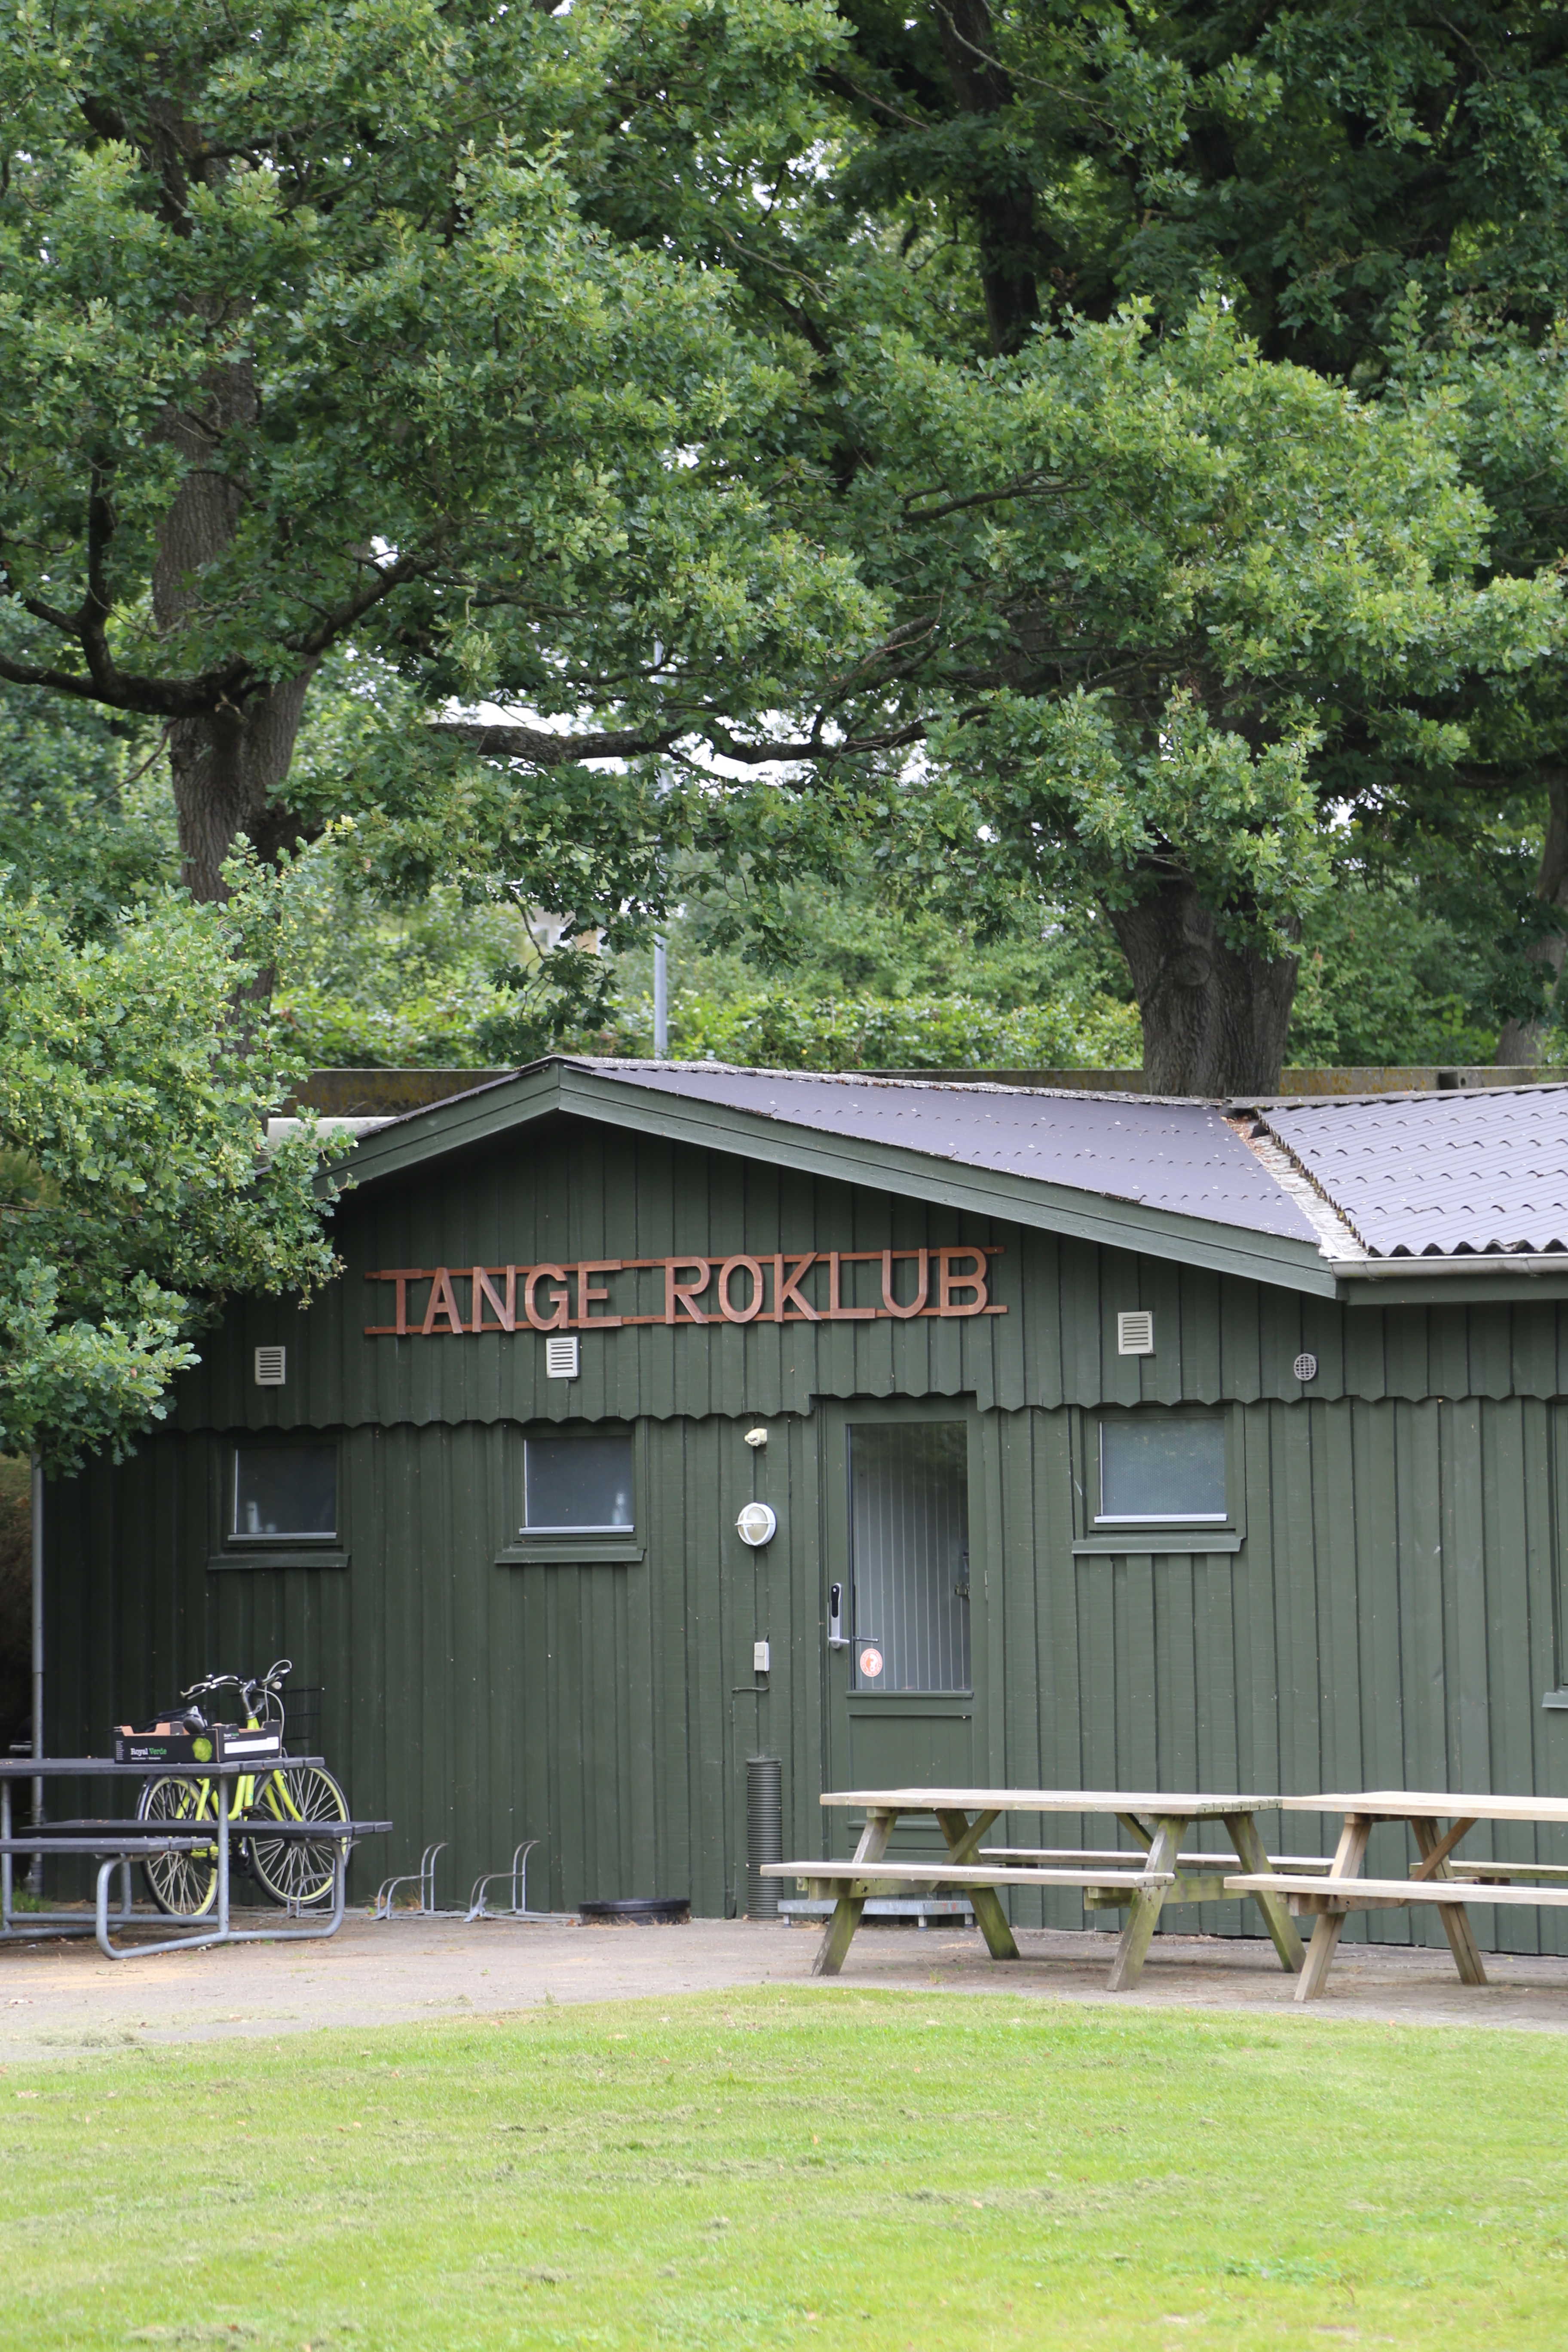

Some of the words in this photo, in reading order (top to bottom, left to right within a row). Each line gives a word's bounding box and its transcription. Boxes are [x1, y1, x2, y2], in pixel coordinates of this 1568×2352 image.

[380, 1260, 623, 1335] TANGE
[665, 1247, 988, 1324] ROKLUB
[130, 1748, 148, 1756] Royal
